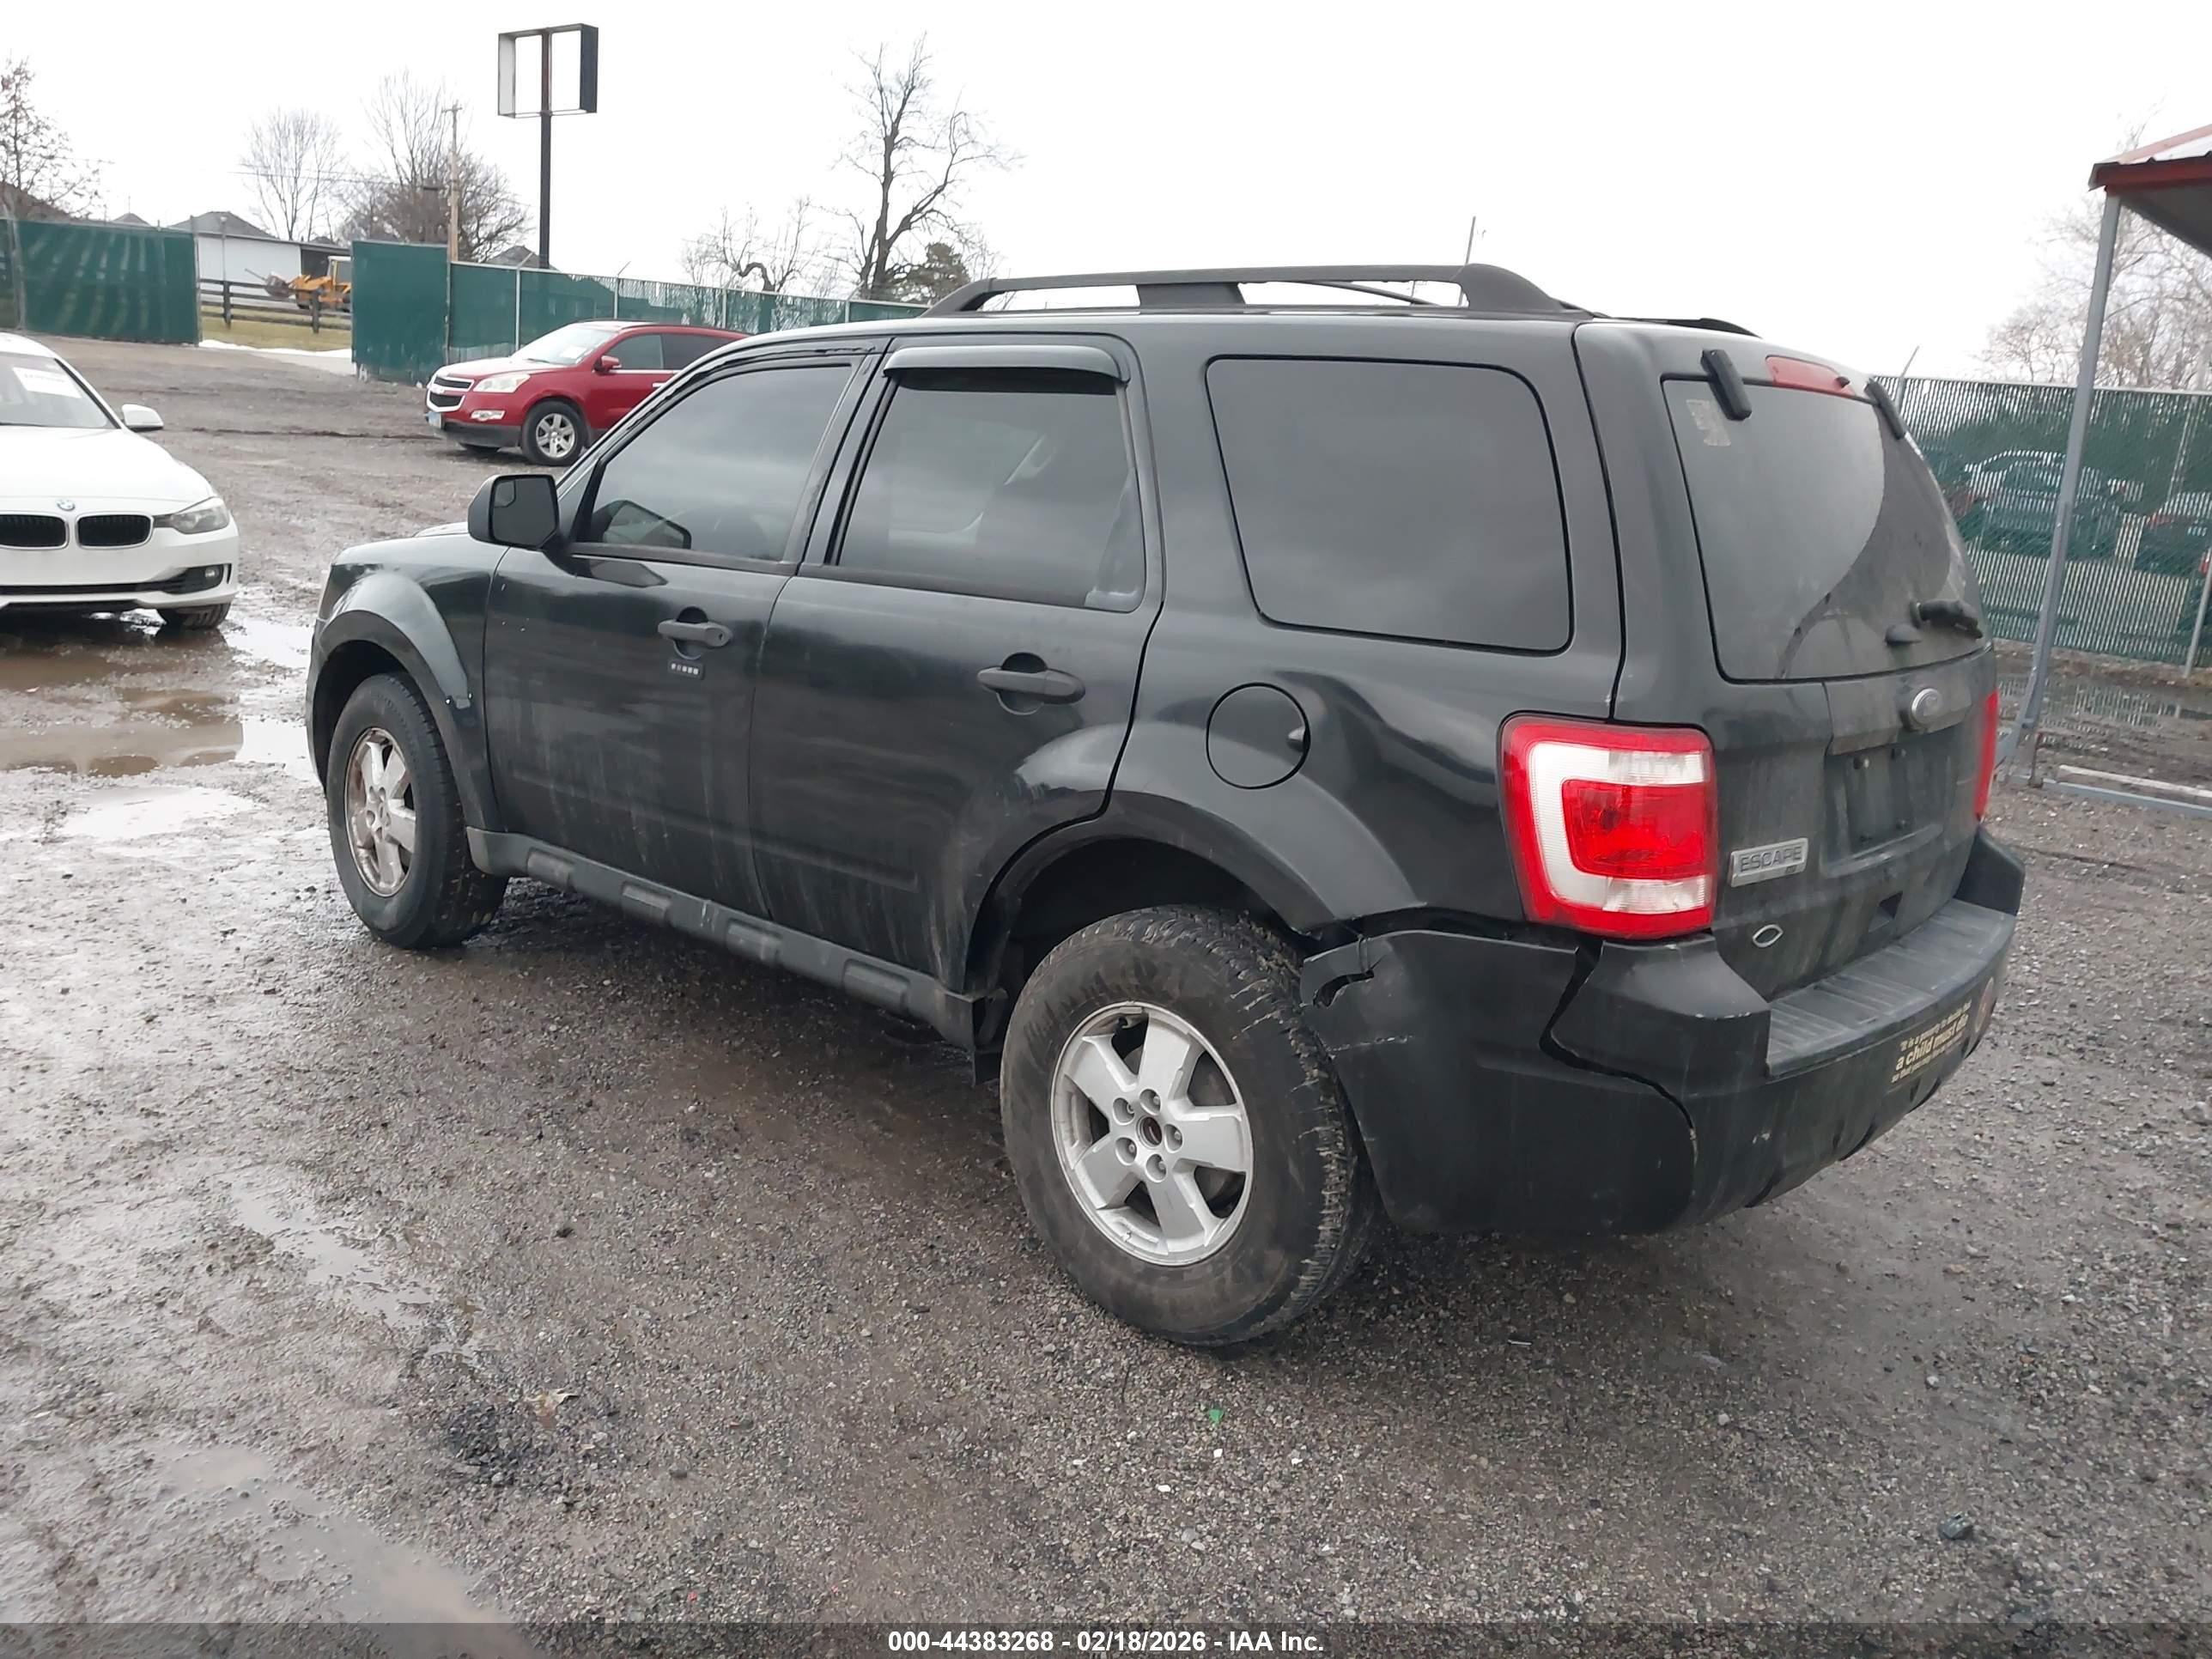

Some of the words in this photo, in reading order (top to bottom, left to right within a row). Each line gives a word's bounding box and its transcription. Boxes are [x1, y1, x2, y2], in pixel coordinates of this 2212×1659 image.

[1740, 845, 1802, 872] ESCAPE
[1895, 1056, 1905, 1071] a
[1905, 1036, 1935, 1066] child
